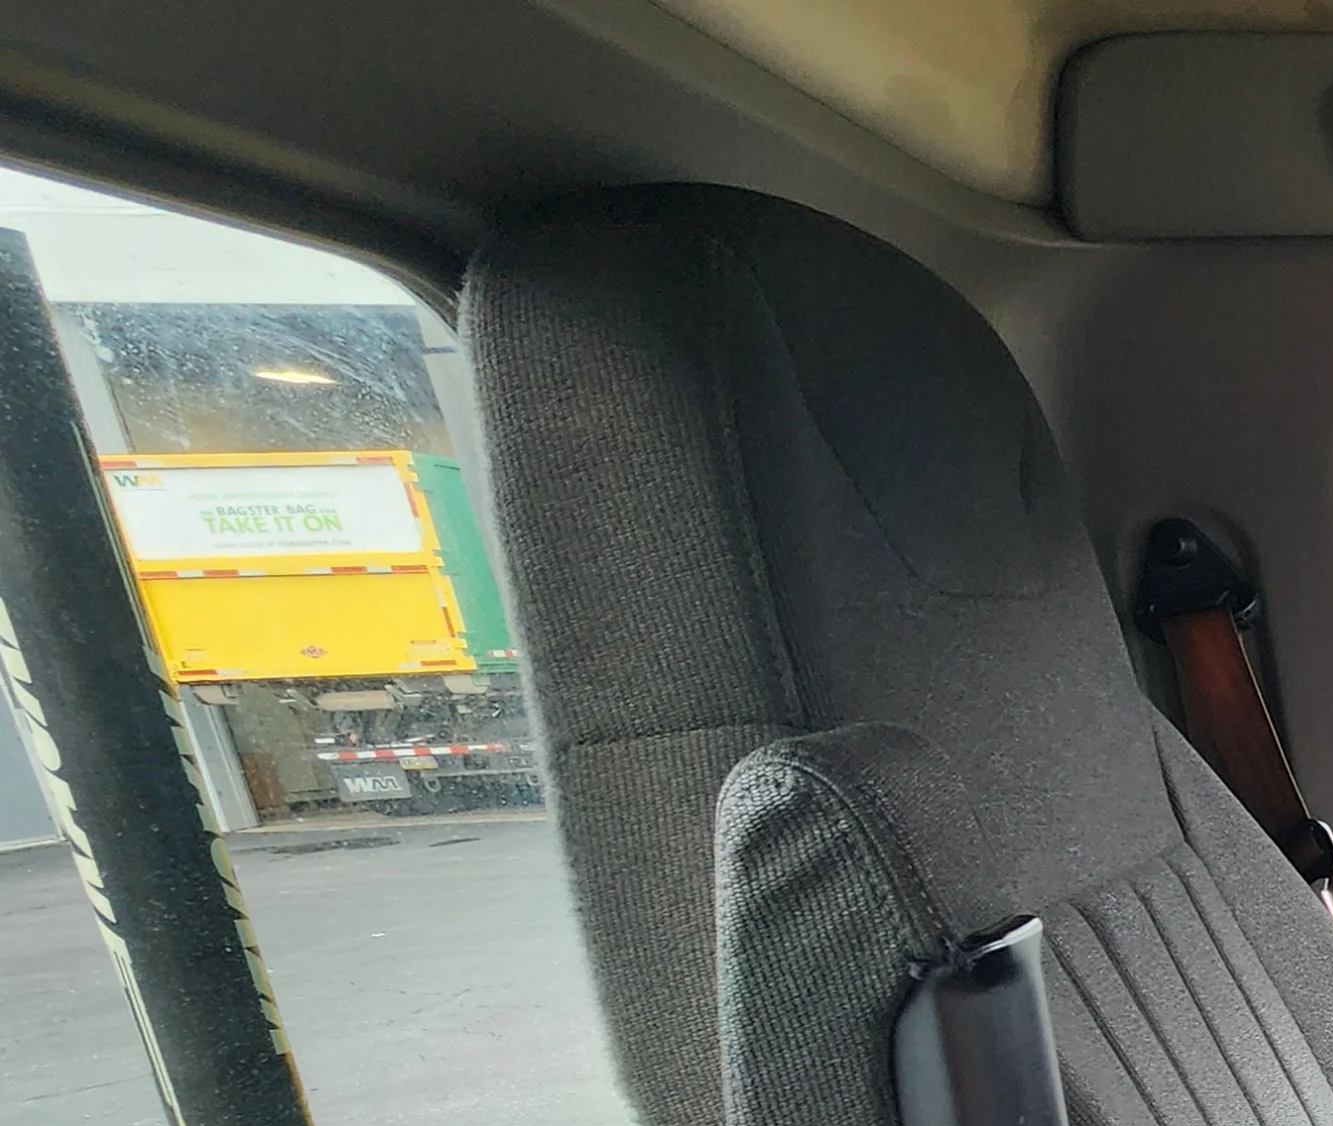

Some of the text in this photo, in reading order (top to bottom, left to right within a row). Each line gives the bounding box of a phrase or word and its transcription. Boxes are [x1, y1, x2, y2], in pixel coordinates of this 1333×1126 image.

[216, 505, 280, 516] BAGSTER
[286, 504, 317, 514] BAG
[202, 514, 344, 534] TAKE IT ON
[344, 776, 403, 793] WM
